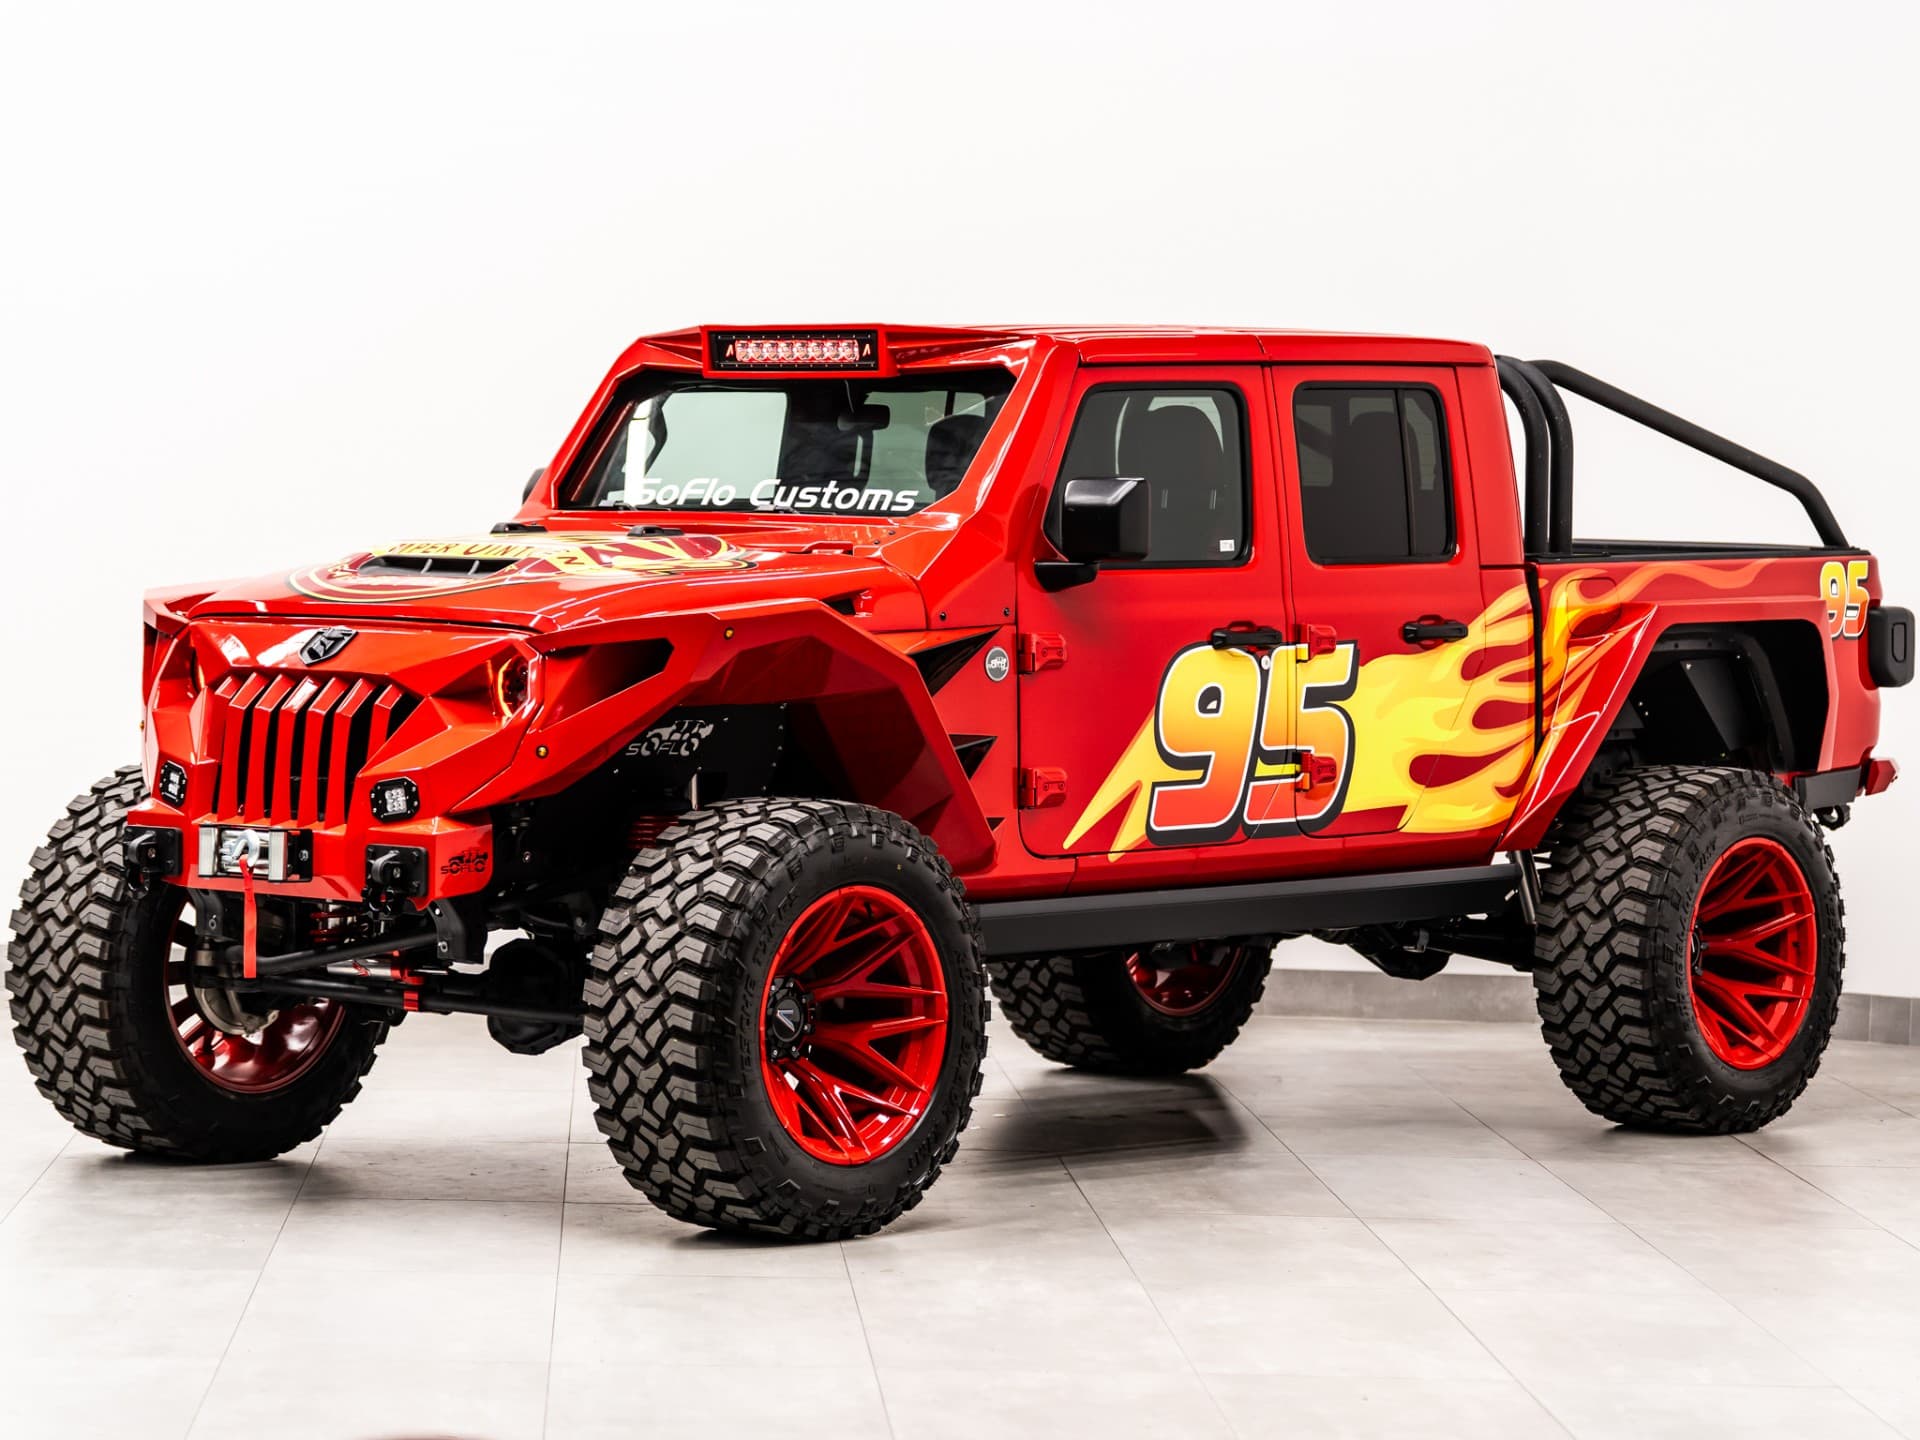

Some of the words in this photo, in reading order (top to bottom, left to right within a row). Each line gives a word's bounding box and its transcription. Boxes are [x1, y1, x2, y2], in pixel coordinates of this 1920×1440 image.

[749, 479, 918, 512] Customs
[1820, 560, 1871, 639] 95
[1146, 639, 1360, 847] 95
